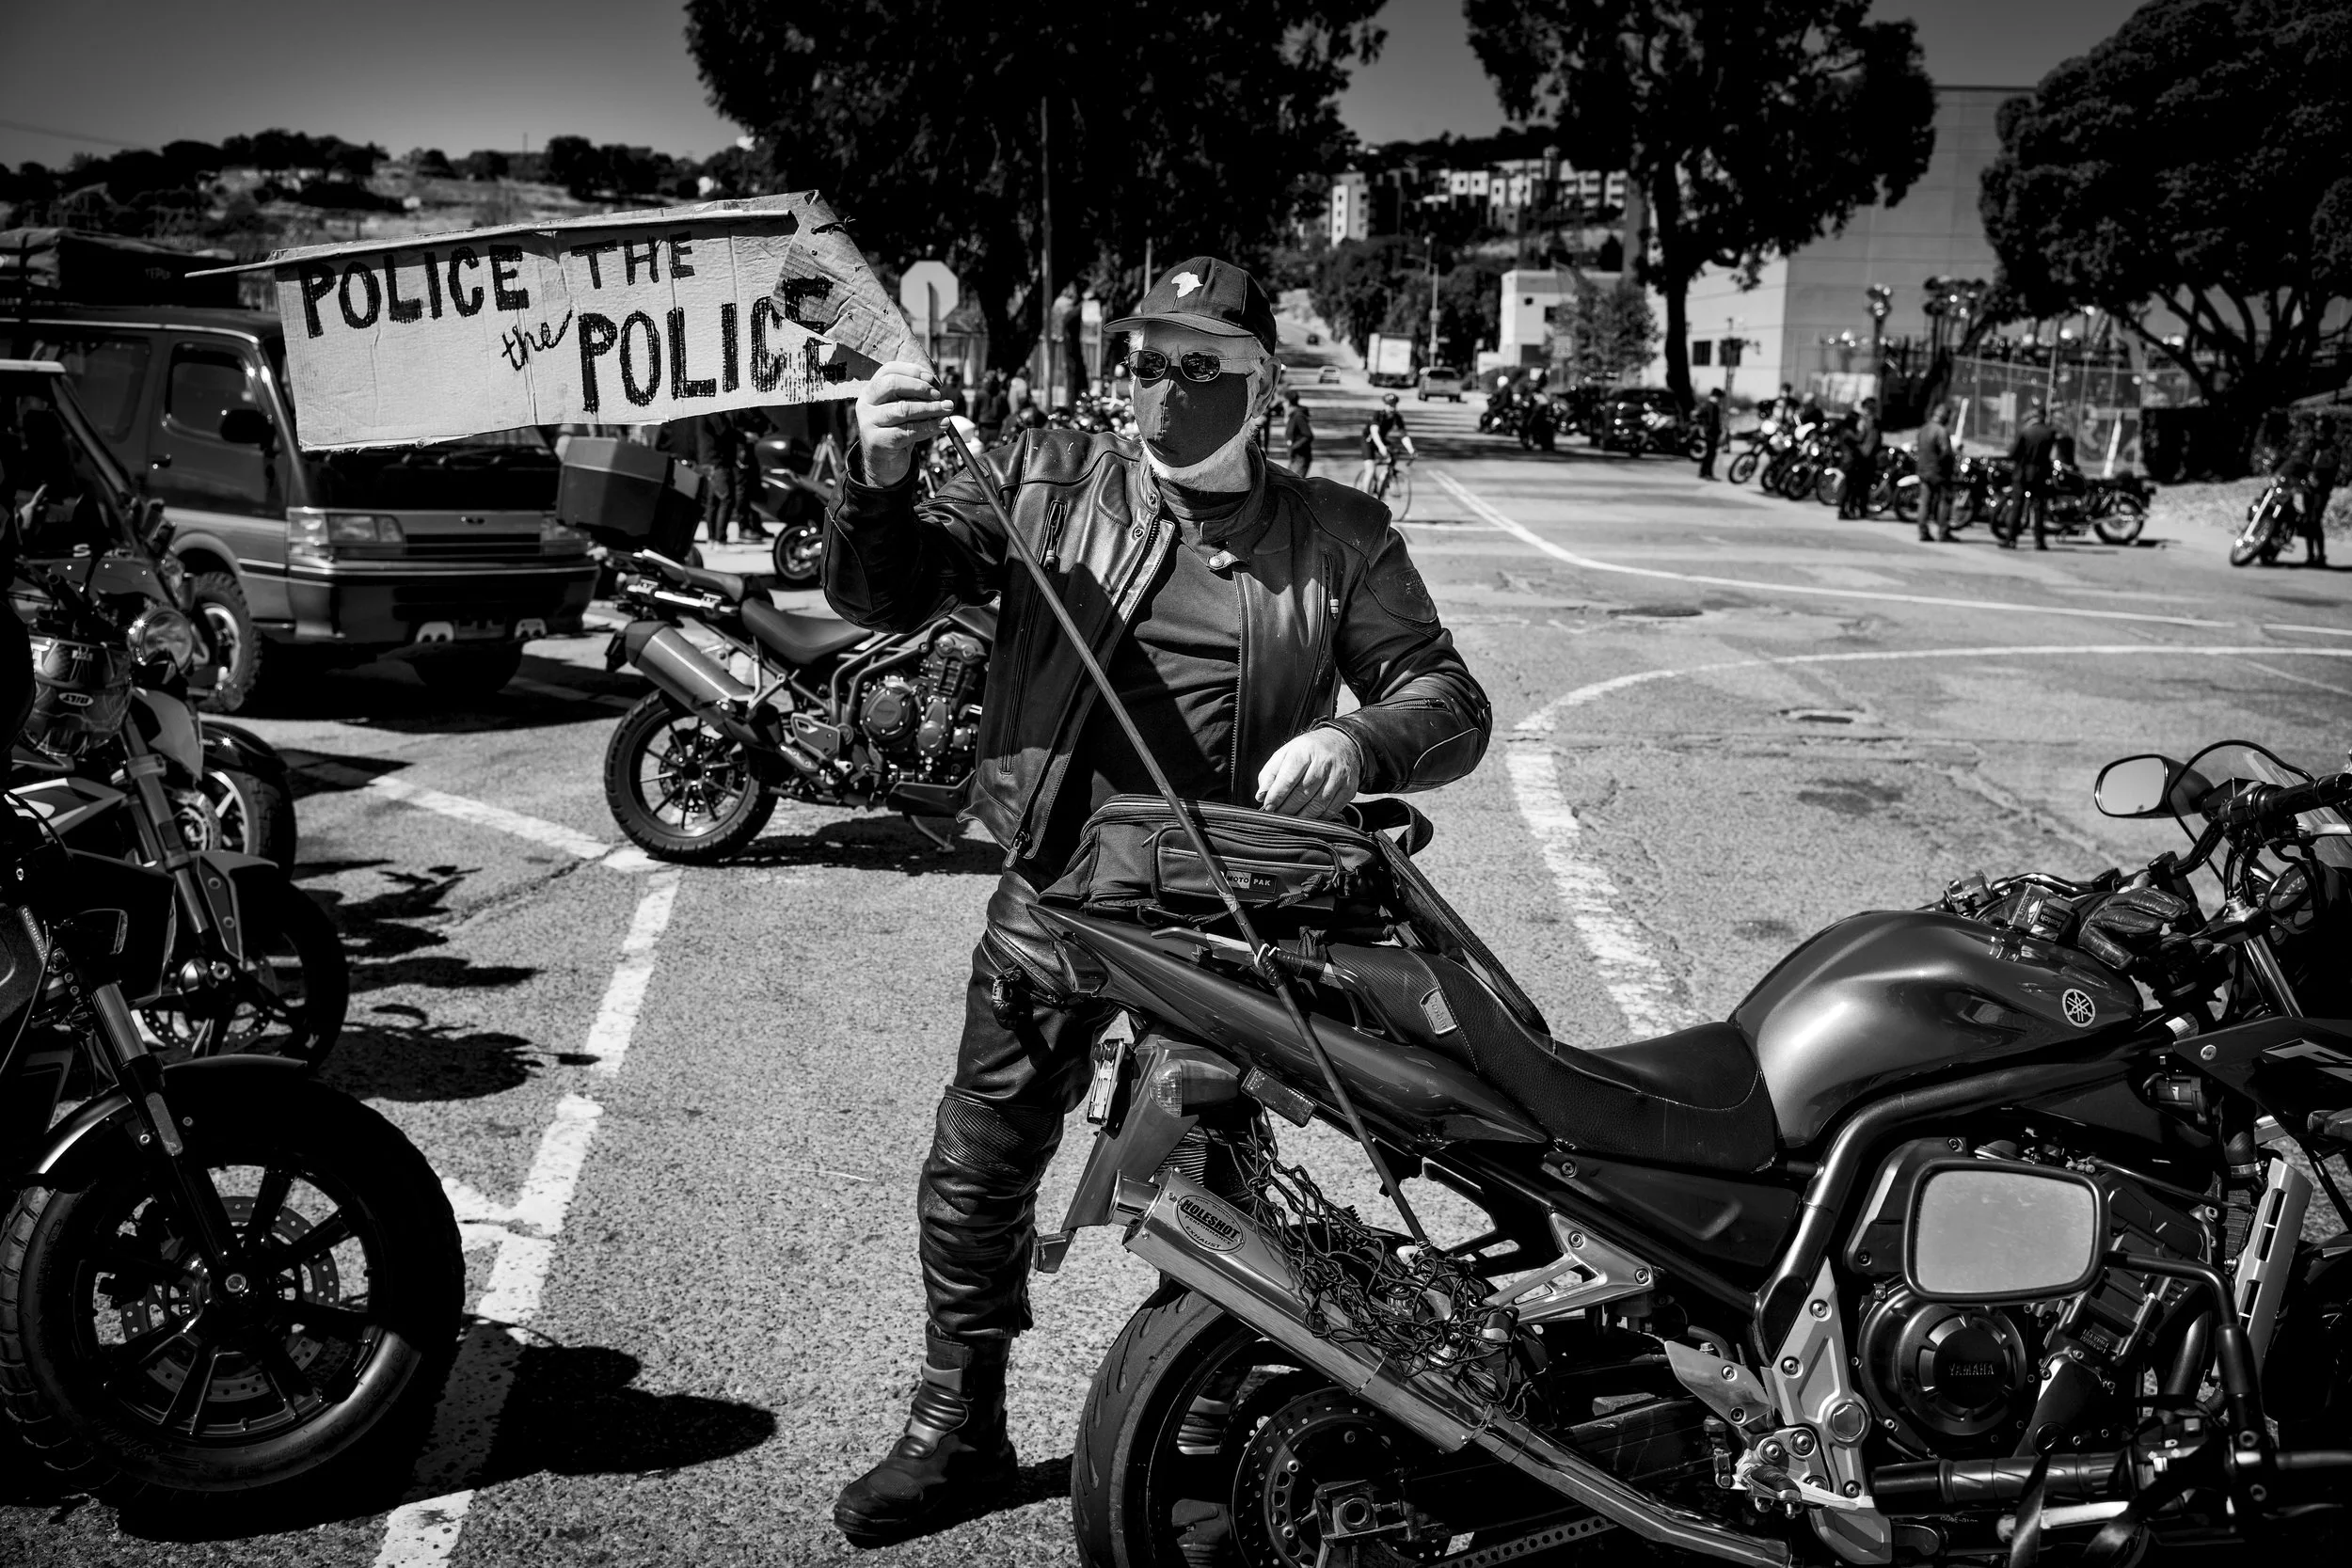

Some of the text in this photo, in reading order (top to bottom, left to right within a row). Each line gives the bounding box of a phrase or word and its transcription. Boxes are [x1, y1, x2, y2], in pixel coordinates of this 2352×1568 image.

[297, 231, 695, 339] POLICE THE
[501, 276, 848, 414] the POLICE
[2040, 913, 2062, 928] Scotch
[1183, 1199, 1240, 1239] HOLESHOT
[1184, 1215, 1232, 1244] PERFORMANCE
[1185, 1226, 1221, 1248] EXHAUST
[1948, 1362, 1994, 1376] YAMAHA
